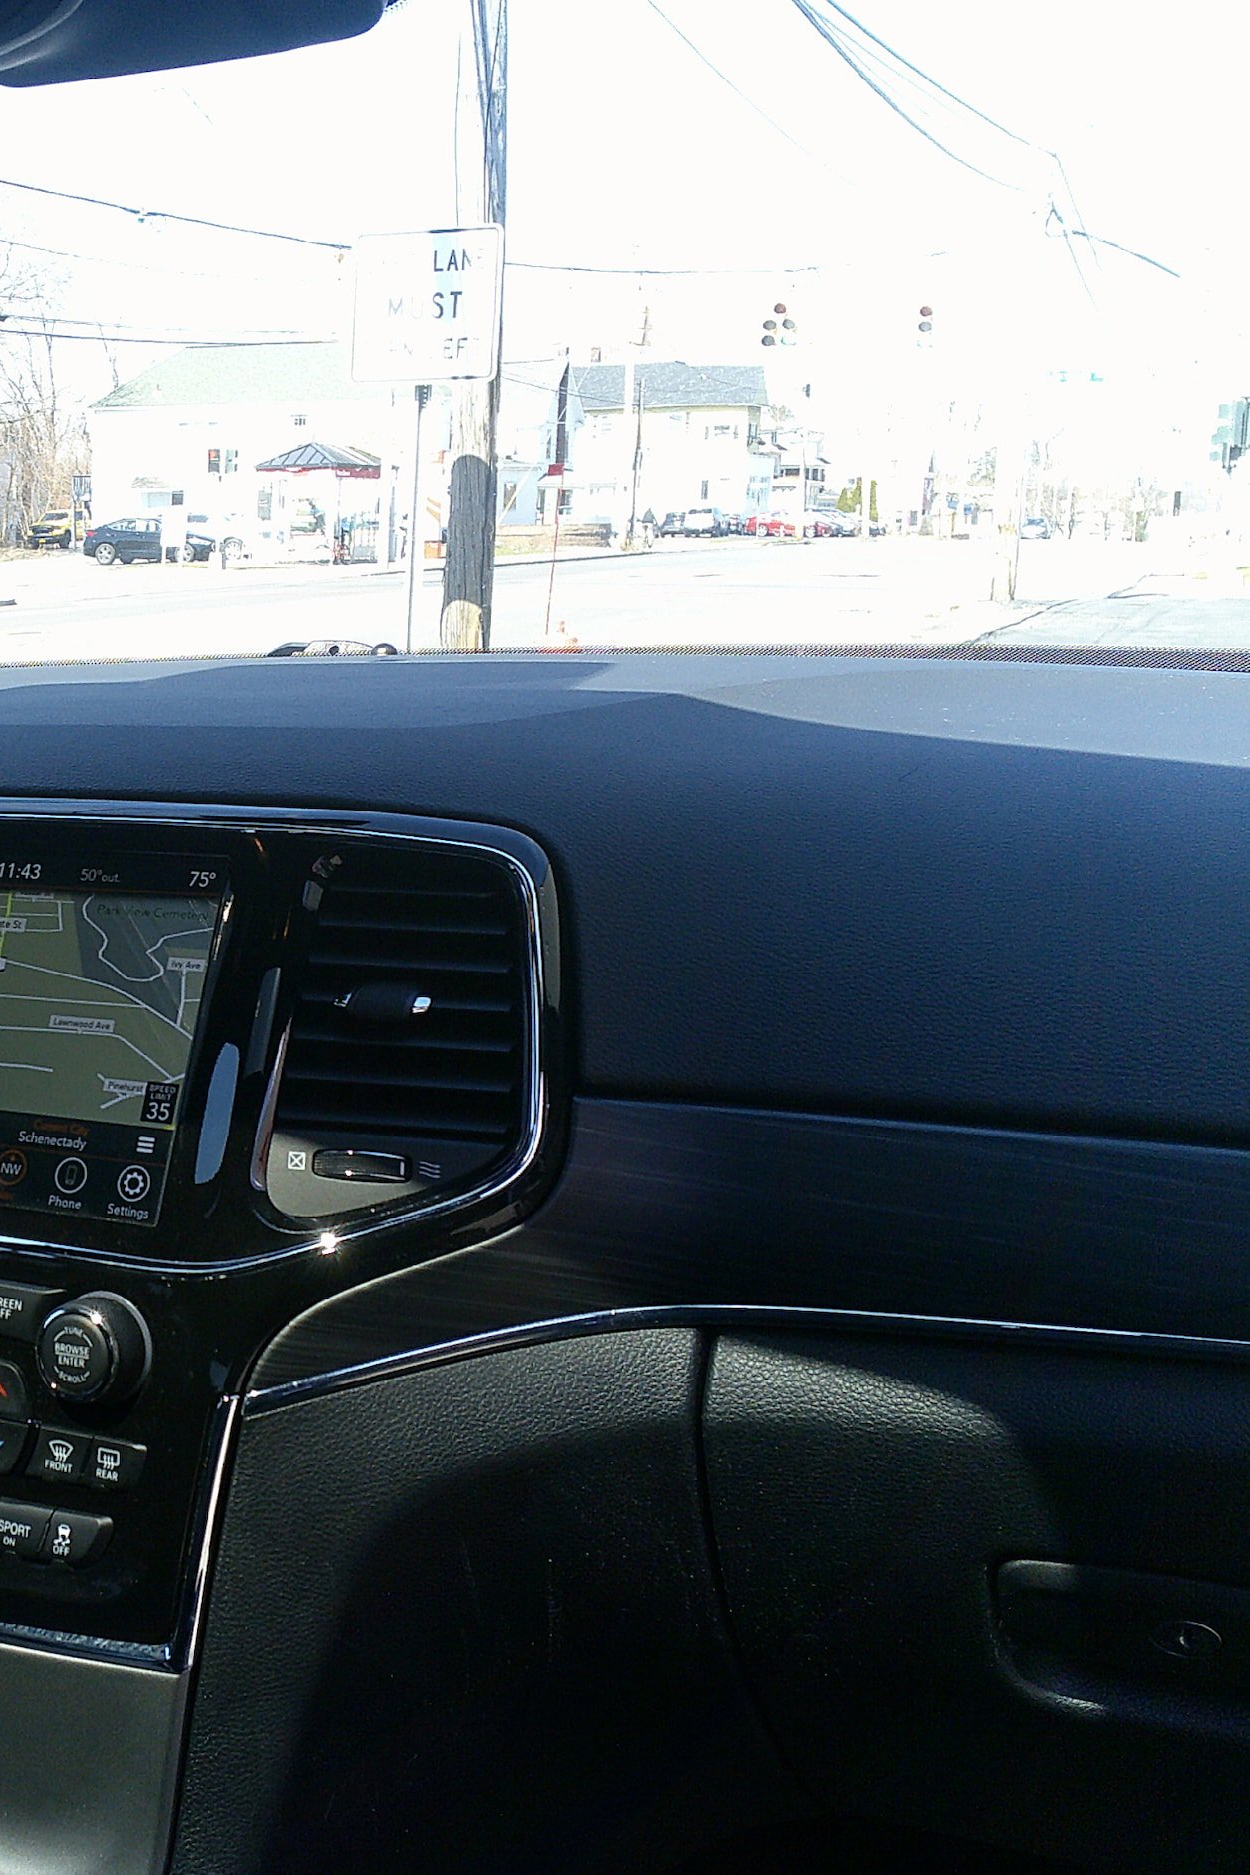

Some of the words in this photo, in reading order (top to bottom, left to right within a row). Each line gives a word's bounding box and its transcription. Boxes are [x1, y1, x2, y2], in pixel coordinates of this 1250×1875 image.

[188, 870, 217, 888] 75°
[13, 920, 23, 930] St
[95, 1021, 111, 1031] Ave
[108, 1081, 143, 1093] Pinehurst
[150, 1084, 176, 1094] SPEED
[150, 1092, 172, 1101] LIMIT
[146, 1102, 171, 1121] 35
[18, 1130, 87, 1151] Schenectady
[0, 1162, 22, 1176] NW
[48, 1195, 82, 1210] Phone
[107, 1203, 149, 1220] Settings
[54, 1342, 90, 1356] BROWSE
[58, 1355, 86, 1368] ENTER
[58, 1371, 86, 1384] SCROLL
[44, 1459, 73, 1474] FRONT
[95, 1467, 119, 1482] REAR
[3, 1535, 16, 1547] ON
[52, 1545, 70, 1557] OFF
